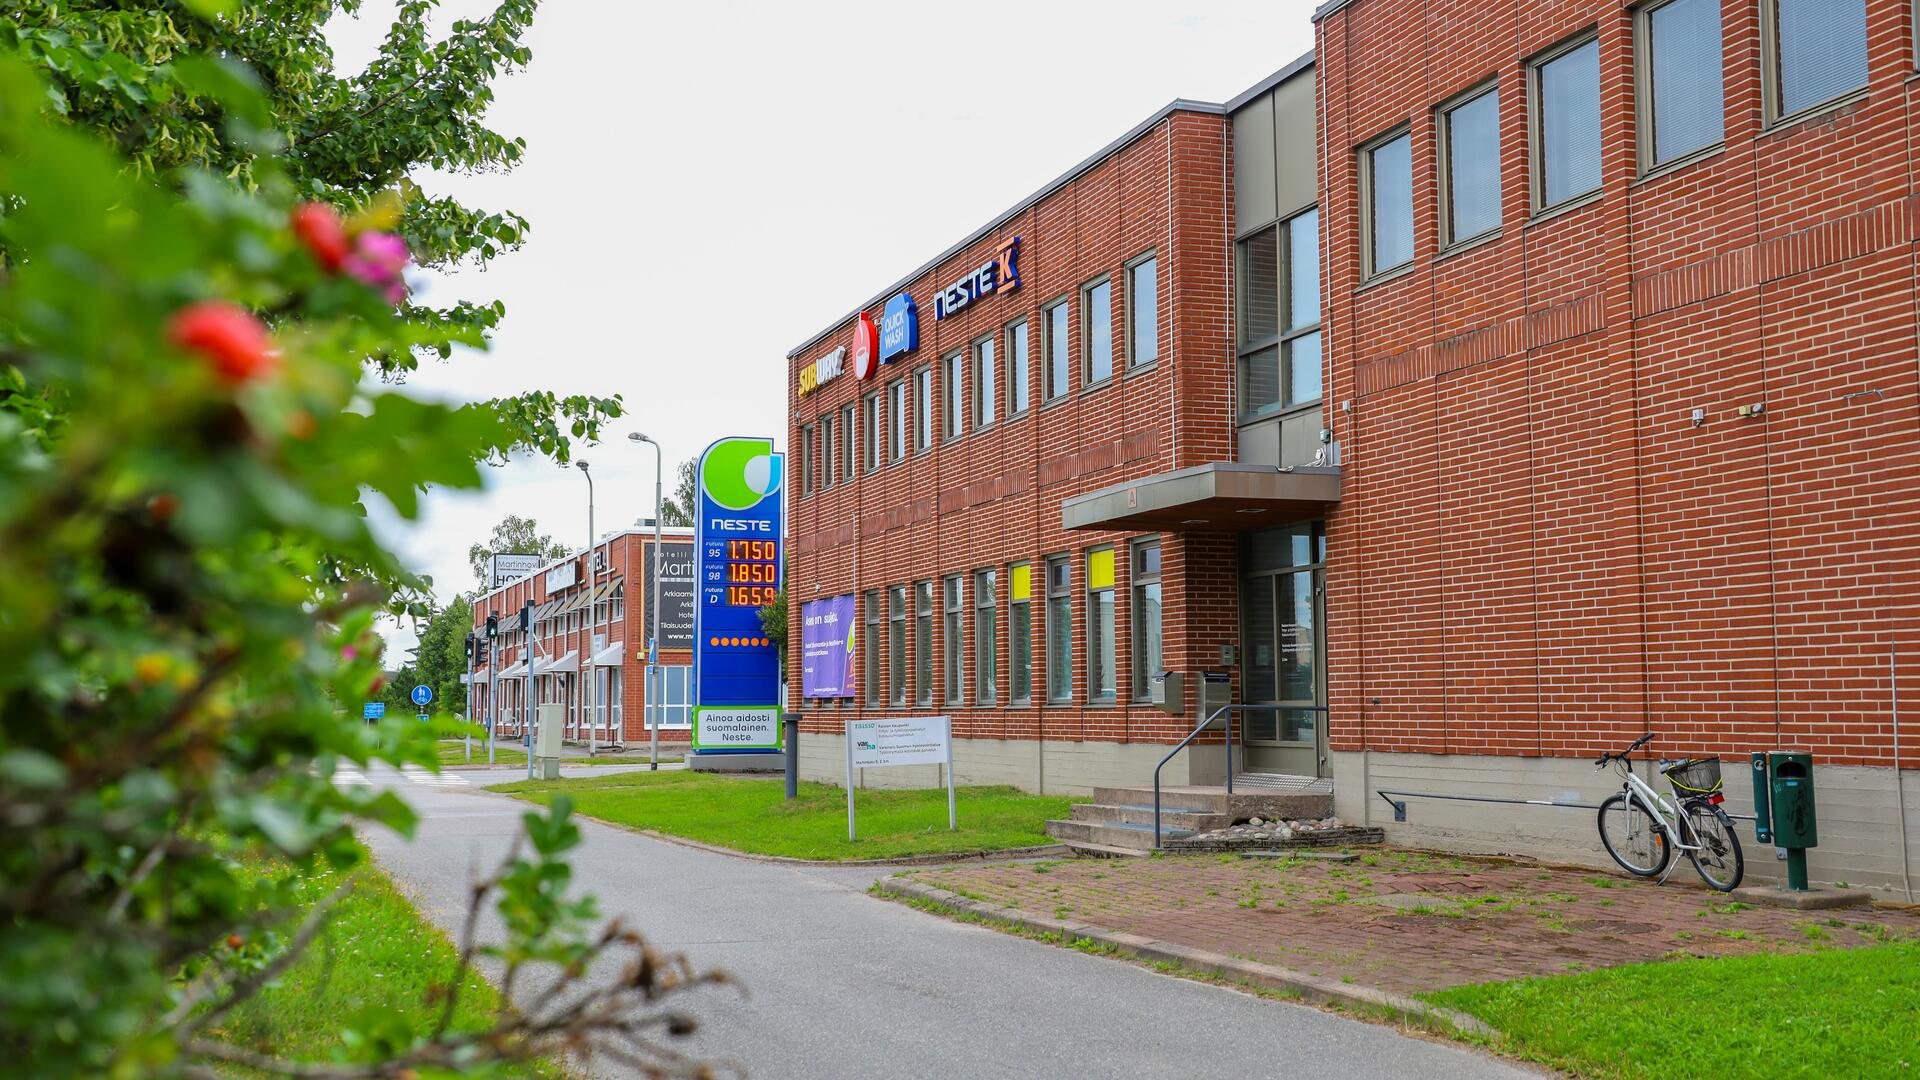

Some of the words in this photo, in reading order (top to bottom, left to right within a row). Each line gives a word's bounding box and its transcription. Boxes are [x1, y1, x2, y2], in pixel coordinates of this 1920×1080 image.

[934, 261, 993, 320] NESTE
[885, 309, 904, 333] QUICK
[885, 326, 904, 349] WASH
[798, 346, 845, 397] SUBWAY
[711, 518, 771, 532] NESTE
[708, 548, 721, 557] 95
[730, 540, 775, 560] 1.750
[708, 571, 721, 580] 98
[730, 563, 775, 583] 1.850
[710, 595, 718, 603] D
[730, 586, 775, 606] 1.659
[706, 714, 733, 722] Ainoa
[736, 713, 770, 722] aidosti
[706, 723, 769, 732] suomalainen.
[722, 733, 754, 741] Neste.
